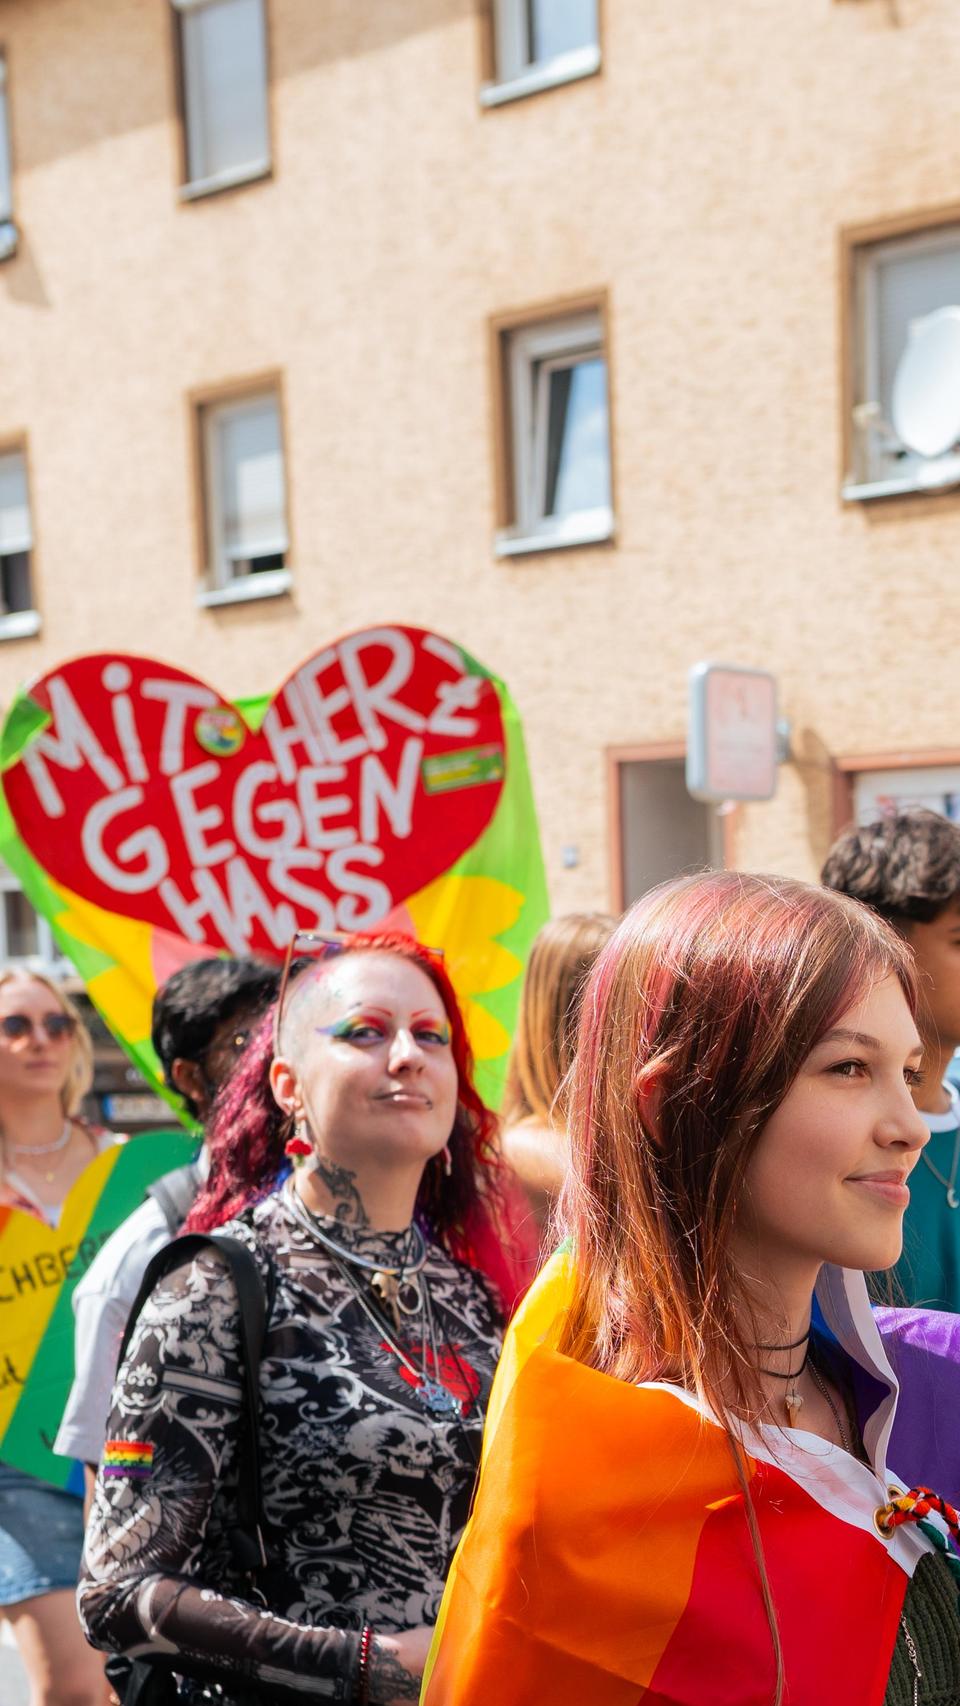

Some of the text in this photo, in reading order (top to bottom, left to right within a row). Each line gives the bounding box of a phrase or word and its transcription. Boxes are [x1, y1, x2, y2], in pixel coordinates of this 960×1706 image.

[262, 626, 487, 784] HERZ
[81, 737, 425, 894] GEGEN
[157, 844, 392, 957] HASS
